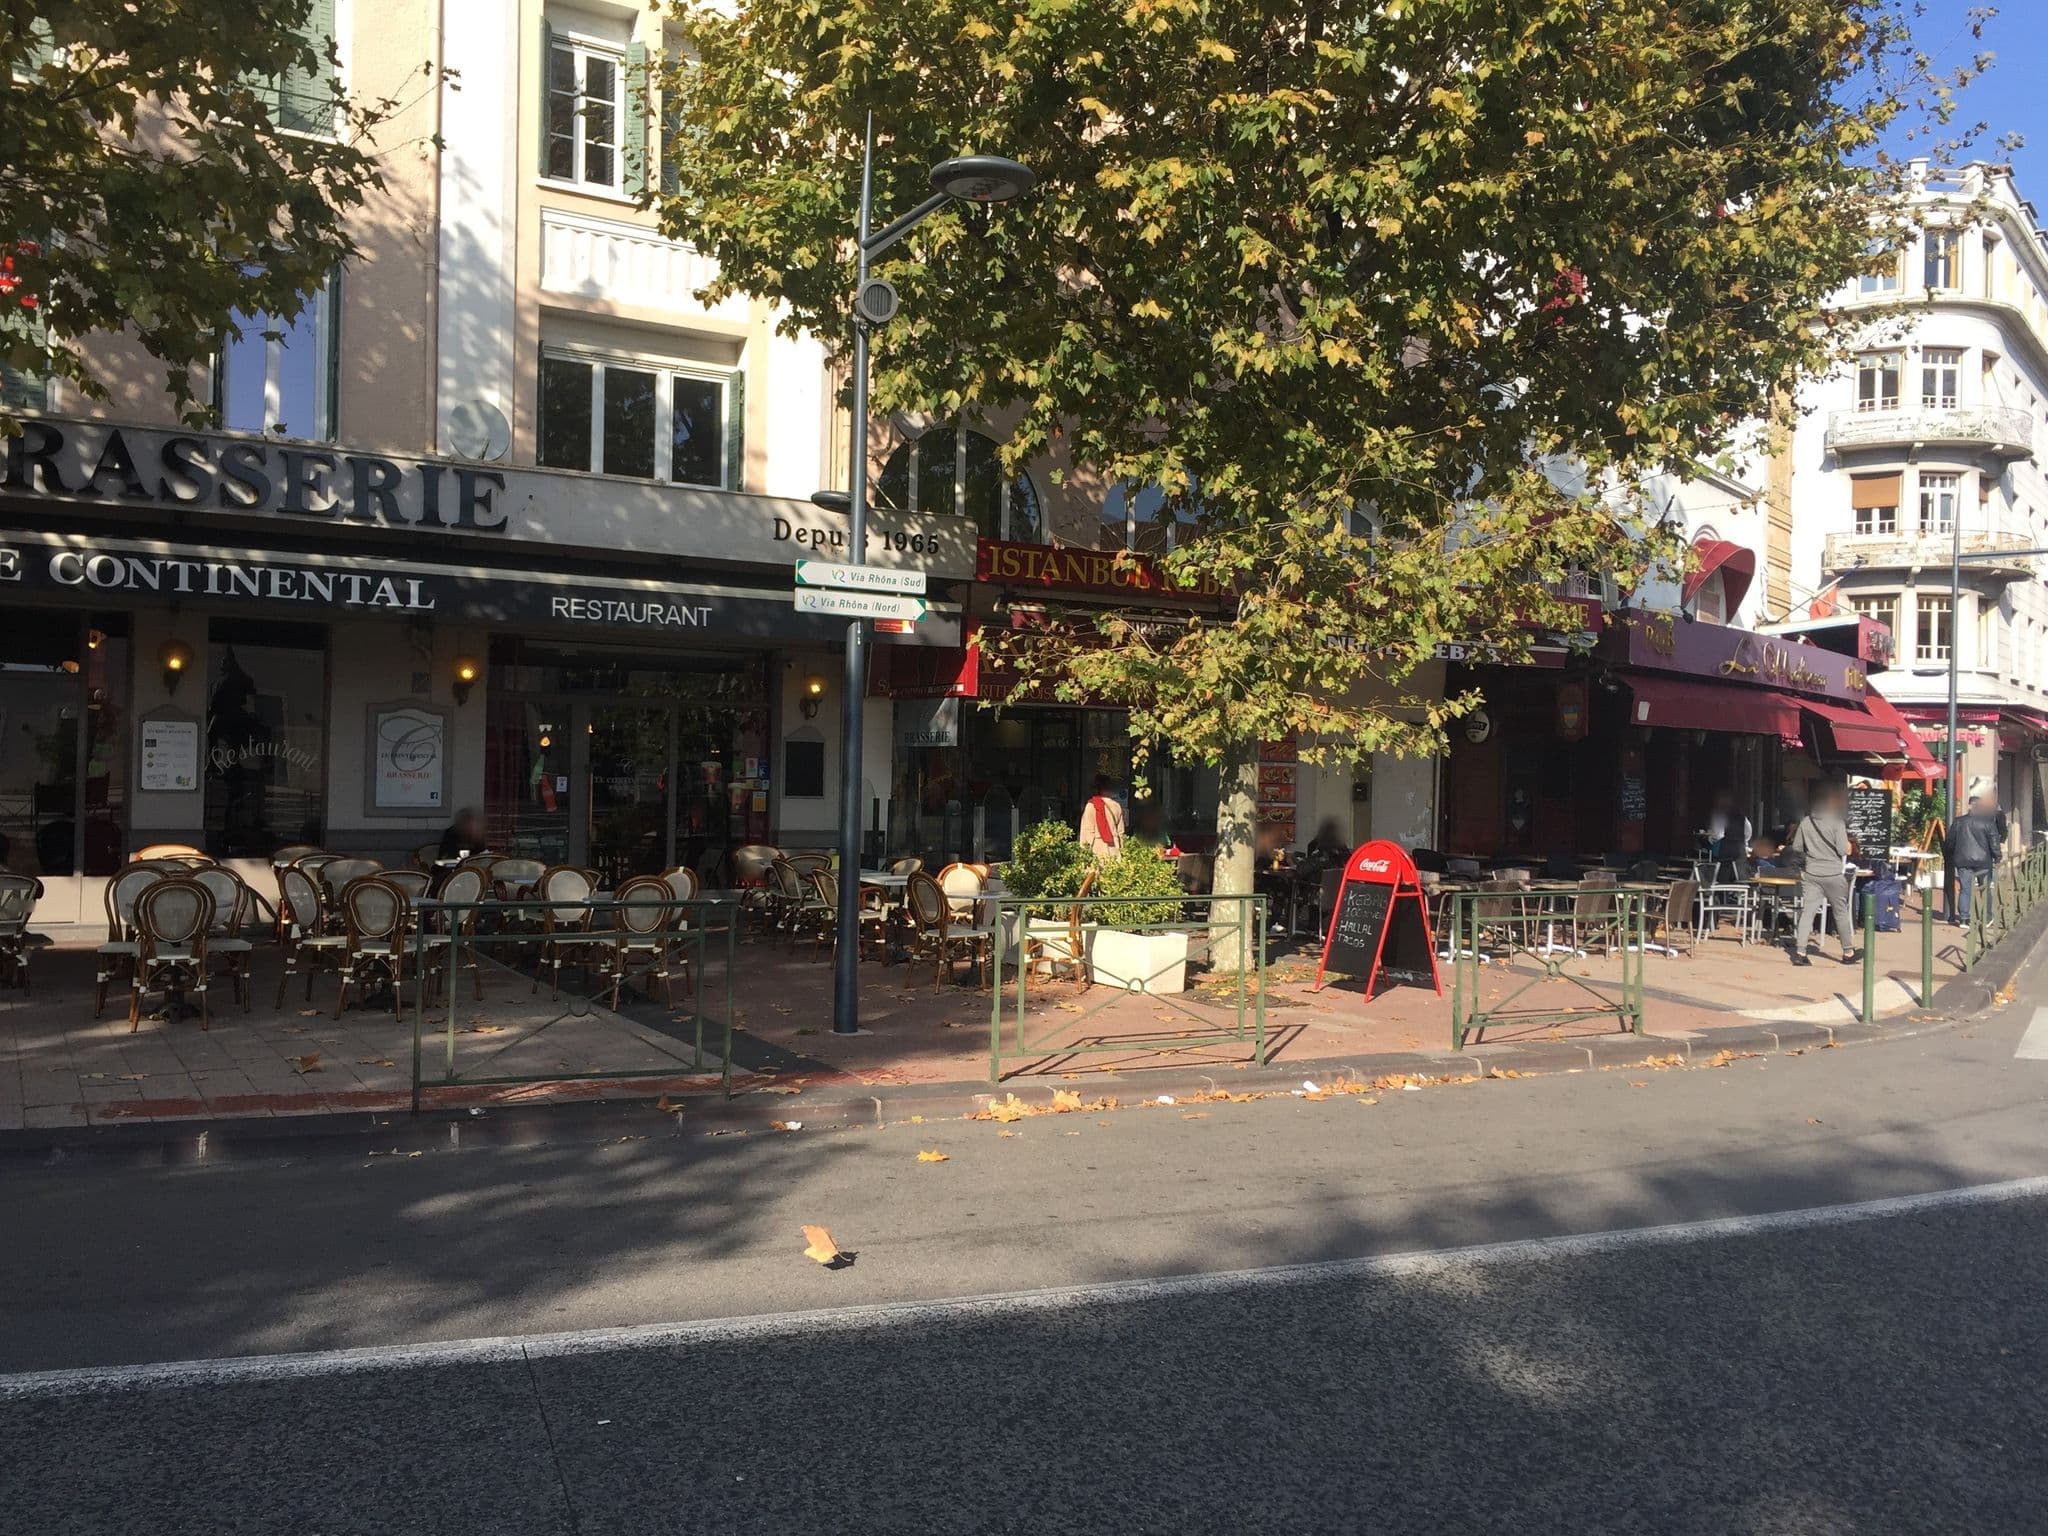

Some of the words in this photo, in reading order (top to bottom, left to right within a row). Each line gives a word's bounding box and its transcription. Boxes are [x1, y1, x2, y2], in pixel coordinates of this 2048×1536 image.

[773, 518, 868, 551] Depu
[883, 531, 939, 554] 1965
[49, 552, 436, 610] CONTINENTAL
[851, 573, 865, 582] Via
[868, 574, 897, 586] Rhôna
[901, 576, 925, 588] (Sud)
[989, 545, 1150, 590] ISTANBUL
[552, 597, 713, 627] RESTAURANT
[821, 598, 836, 607] Via
[839, 600, 868, 610] Rhôna
[872, 602, 900, 613] (Nord)
[904, 731, 950, 744] BRASSERIE
[212, 735, 319, 776] Restaurant
